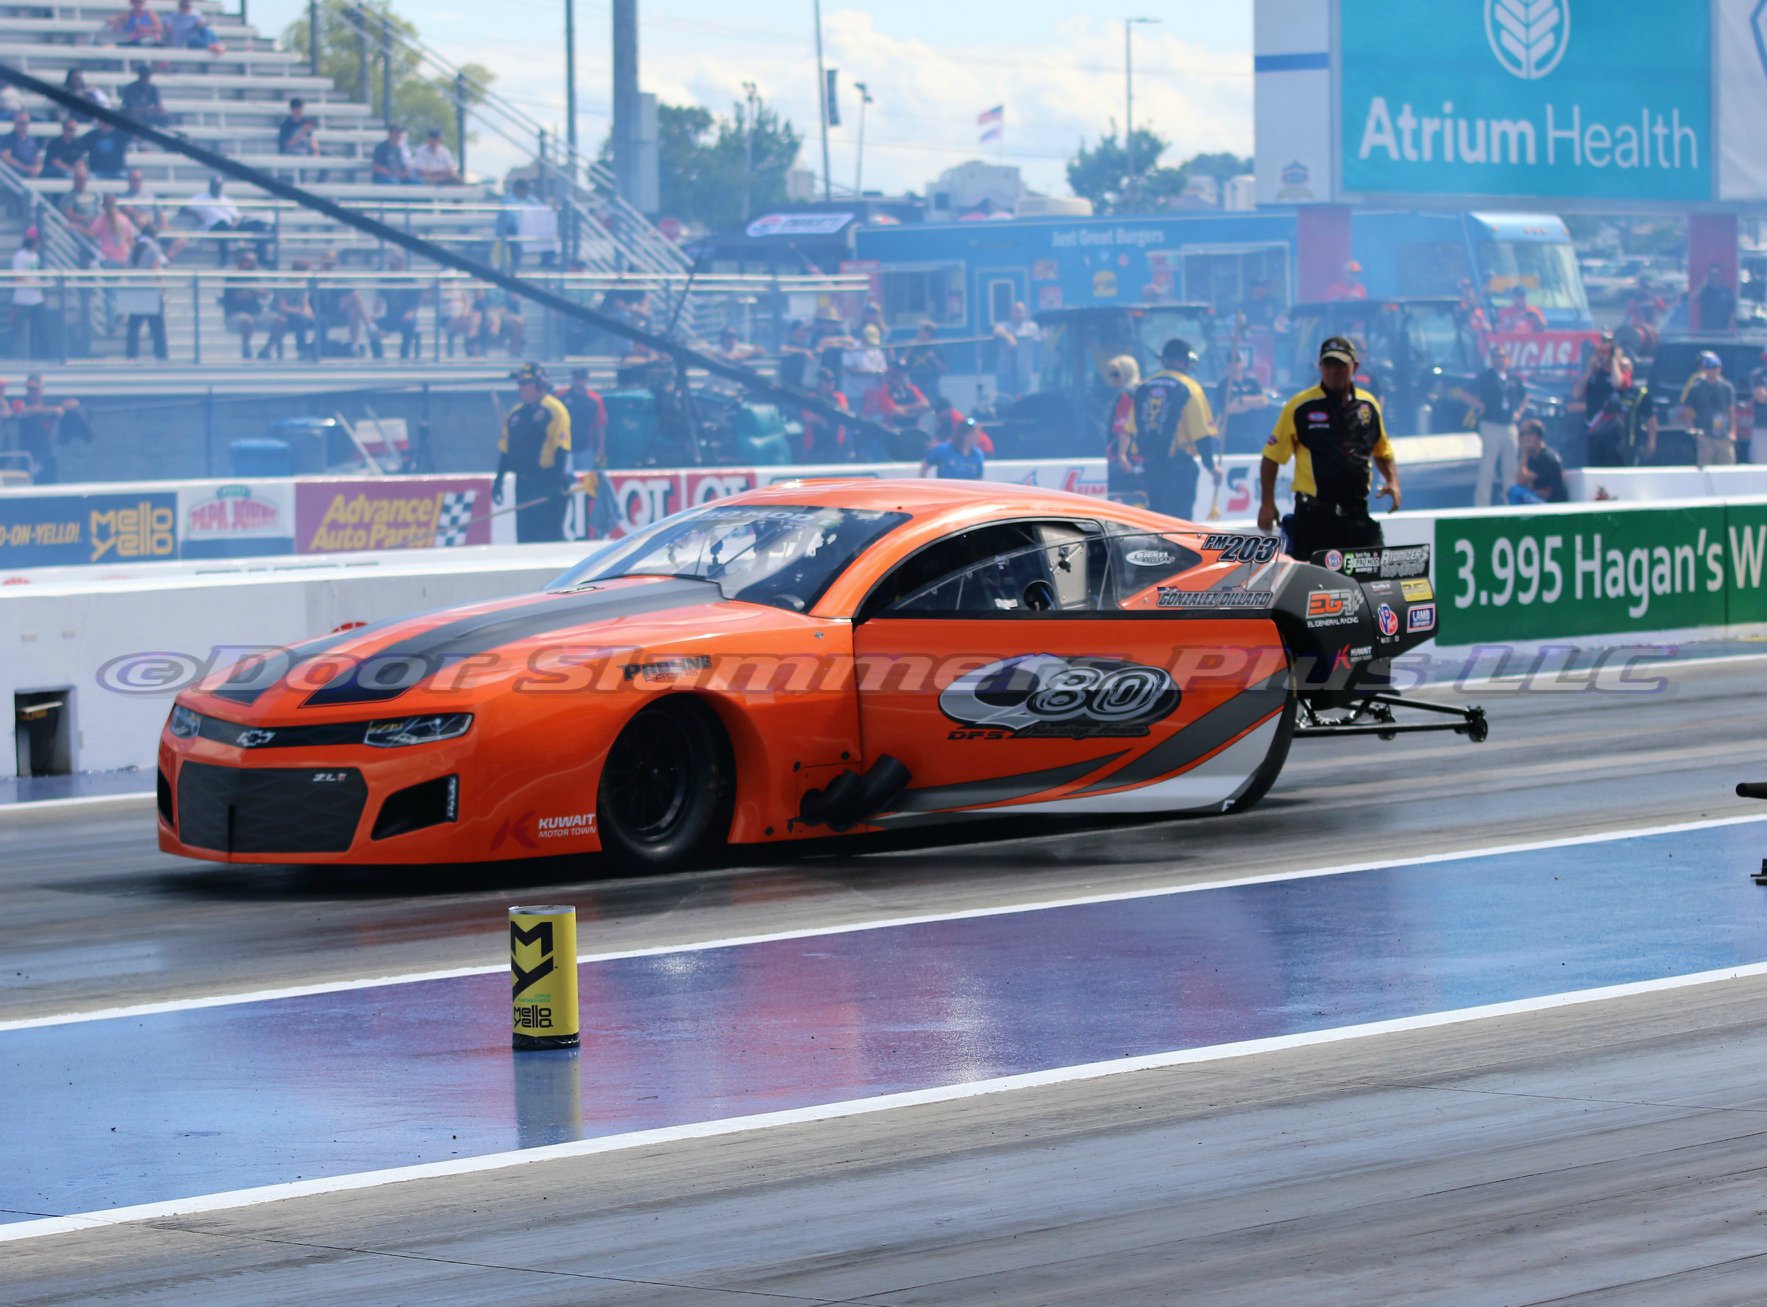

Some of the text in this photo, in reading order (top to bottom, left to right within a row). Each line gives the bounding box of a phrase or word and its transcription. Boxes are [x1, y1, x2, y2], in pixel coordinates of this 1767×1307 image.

[1358, 96, 1699, 170] Atrium Health
[1080, 228, 1114, 246] Great
[1116, 227, 1165, 248] Burgers
[190, 499, 226, 531] PAPA
[327, 493, 434, 524] Advance
[309, 521, 433, 551] Auto Parts
[1203, 534, 1279, 563] PM 203
[1454, 535, 1564, 609] 3.995
[1575, 524, 1724, 620] Hagan's
[1315, 619, 1340, 627] GENERAL
[1340, 617, 1358, 625] RACING
[947, 730, 1005, 741] DFS
[538, 813, 597, 830] KUWAIT
[538, 825, 597, 839] MOTOR TOWN
